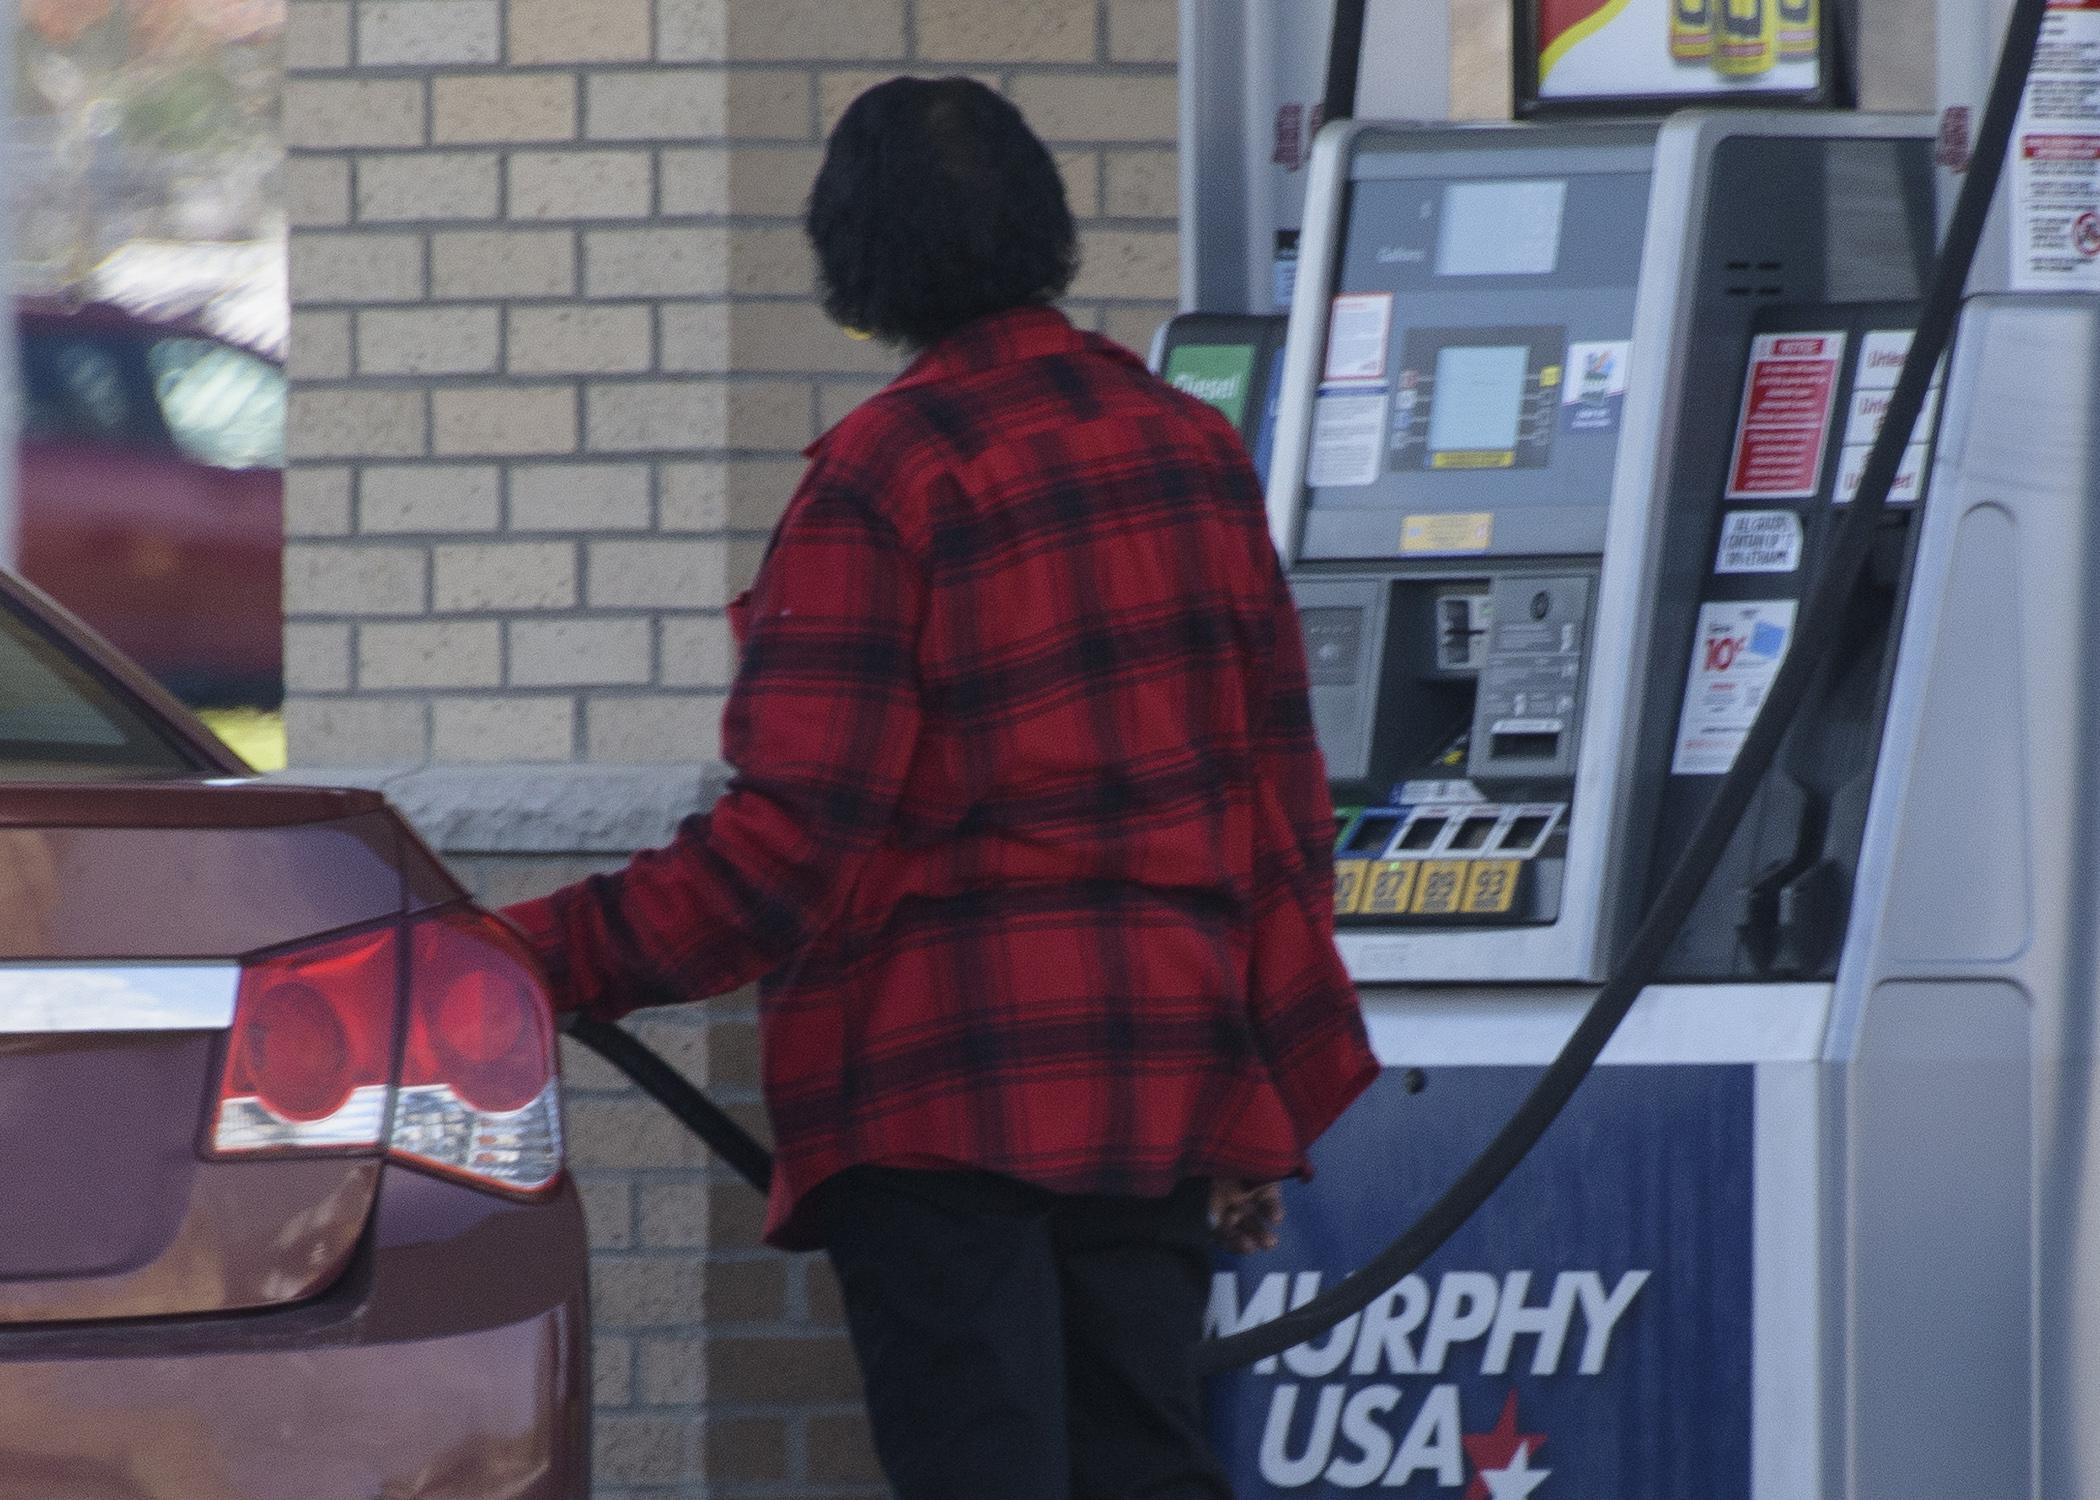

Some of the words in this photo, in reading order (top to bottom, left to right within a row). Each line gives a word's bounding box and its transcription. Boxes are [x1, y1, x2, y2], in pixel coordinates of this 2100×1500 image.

[1373, 870, 1405, 898] 87
[1476, 870, 1507, 897] 93
[1258, 1383, 1464, 1489] USA
